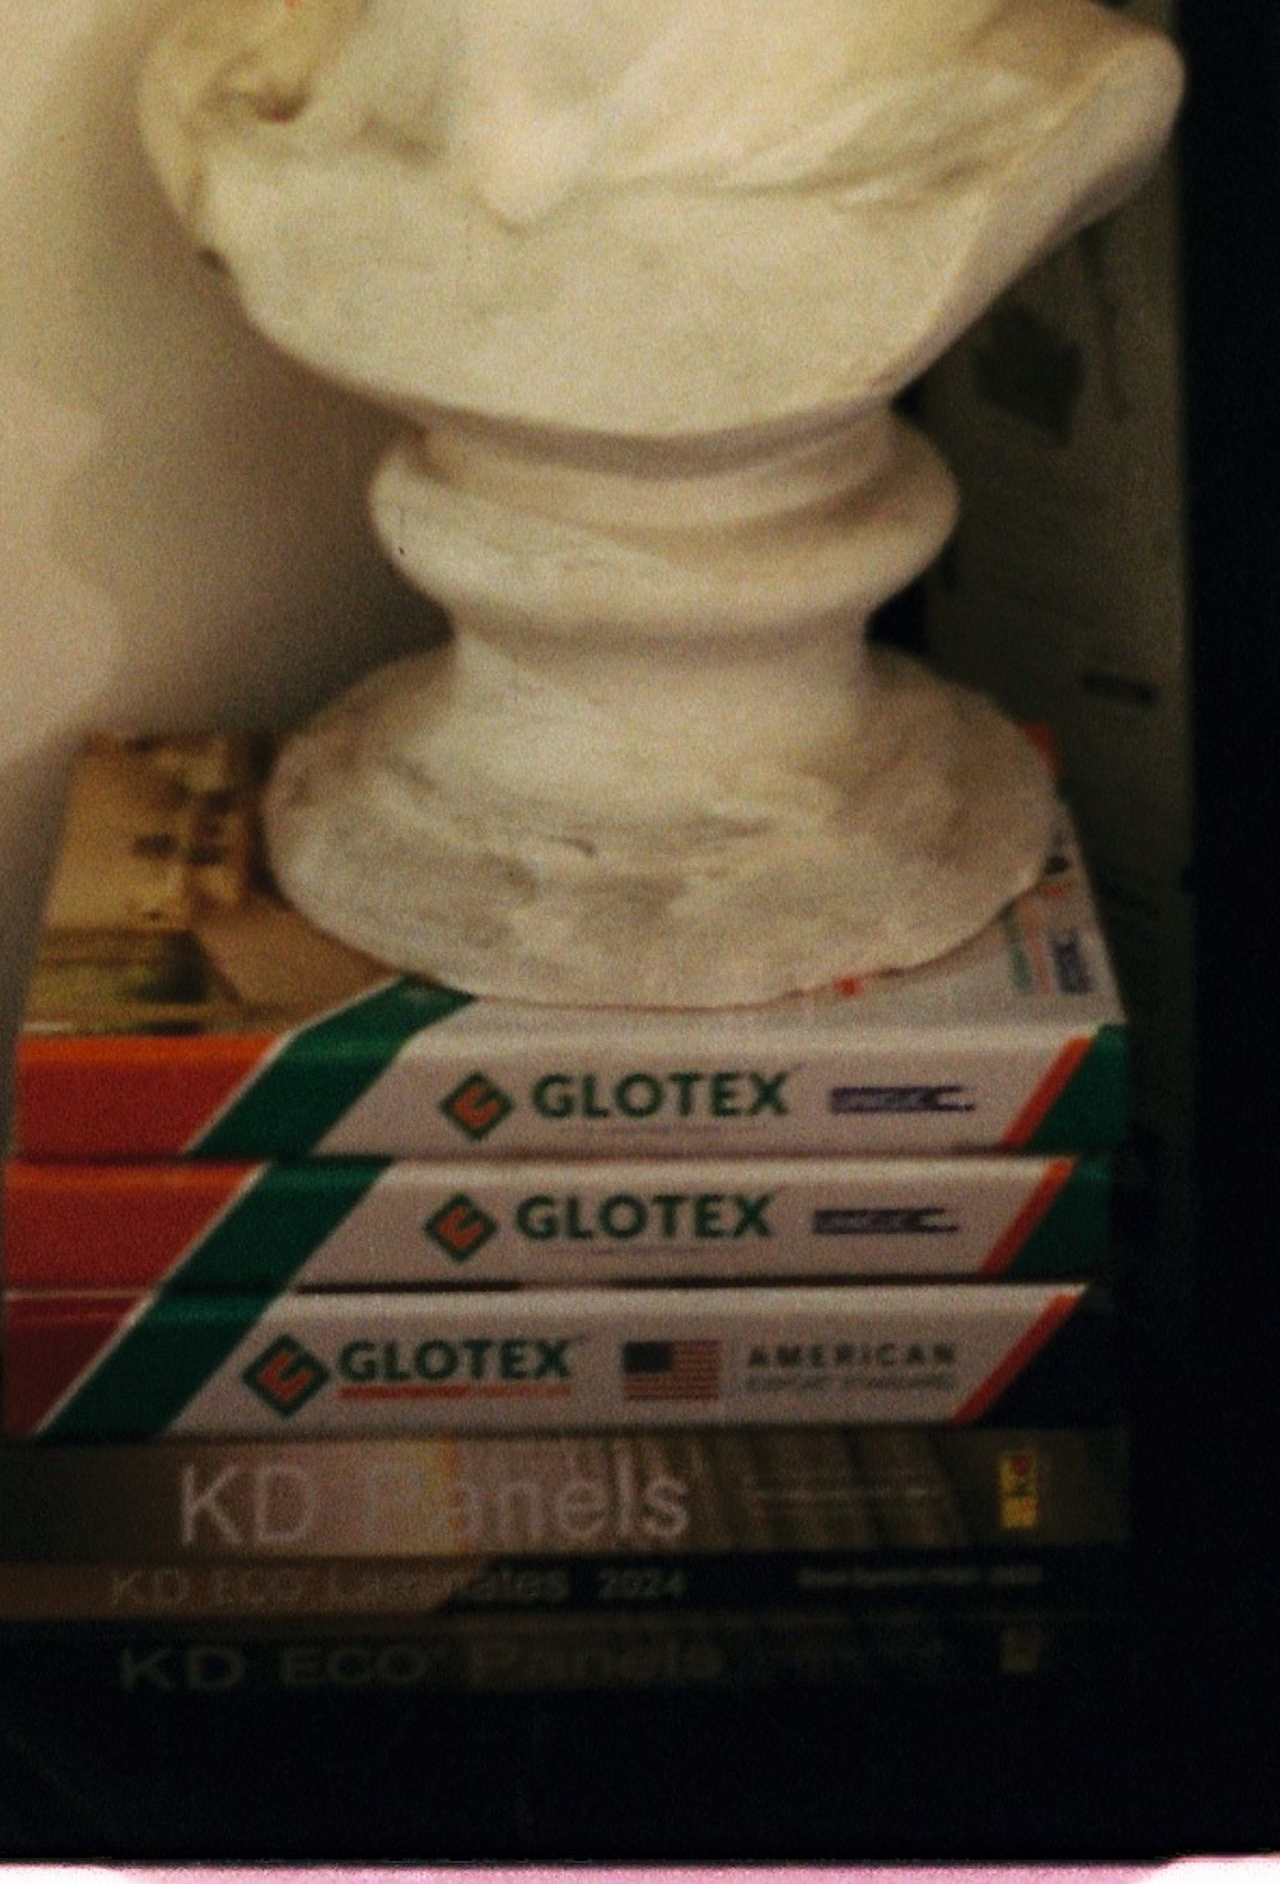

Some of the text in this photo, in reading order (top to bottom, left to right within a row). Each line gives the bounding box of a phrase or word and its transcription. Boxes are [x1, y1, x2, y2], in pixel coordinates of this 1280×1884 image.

[531, 1071, 789, 1120] GLOTEX
[514, 1193, 773, 1241] GLOTEX
[337, 1337, 573, 1382] GLOTEX
[746, 1342, 958, 1368] AMERICAN
[178, 1452, 692, 1547] KD Panels
[110, 1566, 191, 1608] KD
[210, 1567, 306, 1606] ECO
[596, 1567, 687, 1602] 2024
[119, 1639, 724, 1694] KD ECO Panels
